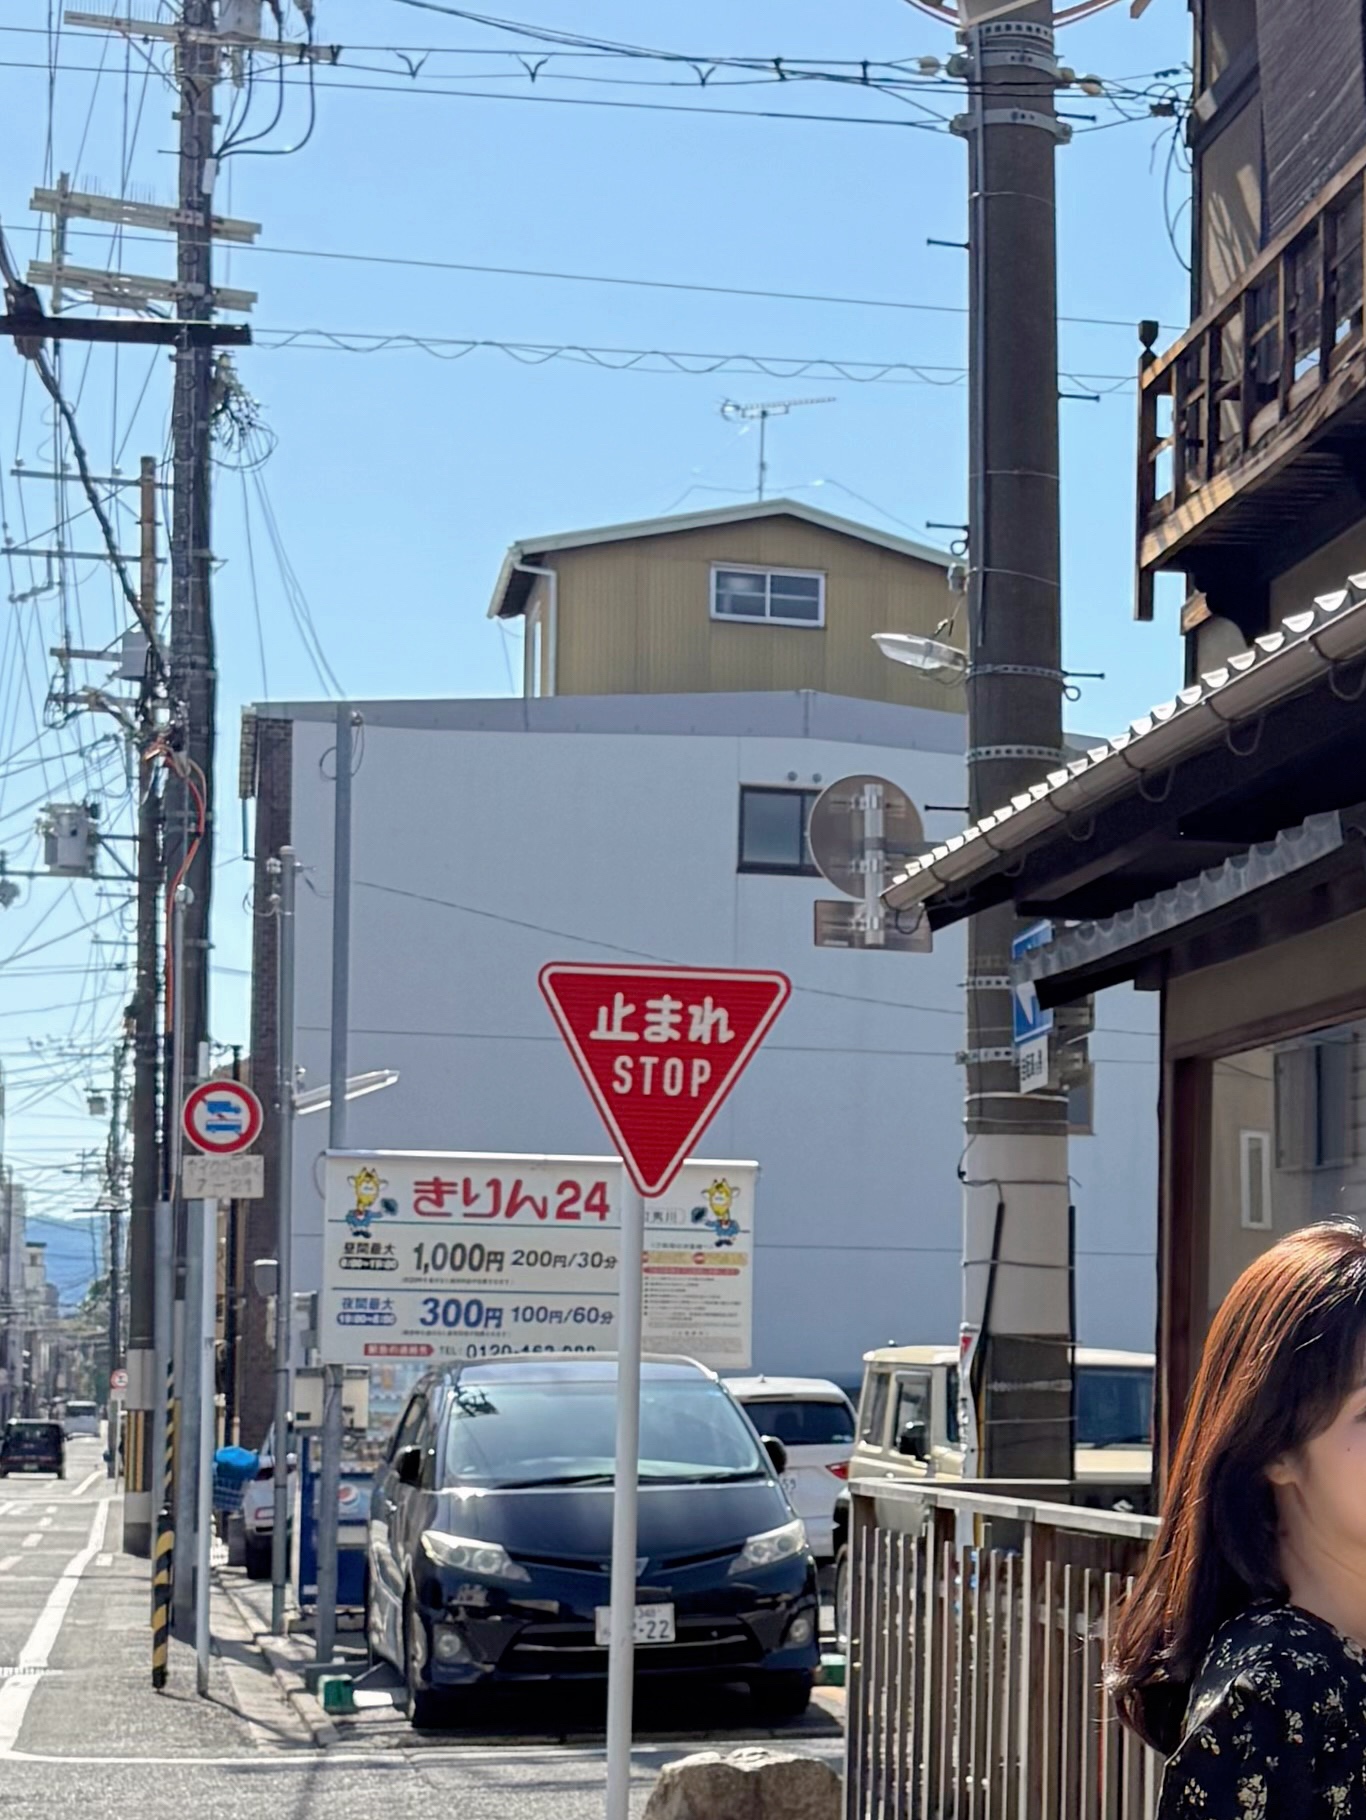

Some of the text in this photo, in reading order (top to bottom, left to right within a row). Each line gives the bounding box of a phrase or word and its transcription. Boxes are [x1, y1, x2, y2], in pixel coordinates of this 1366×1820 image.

[589, 992, 735, 1044] 止まれ
[612, 1055, 711, 1097] STOP
[413, 1177, 610, 1221] きりん24
[413, 1242, 505, 1274] 1,000円
[511, 1249, 618, 1269] 200円/30分
[419, 1297, 503, 1329] 300円
[511, 1306, 614, 1325] 100円/60分
